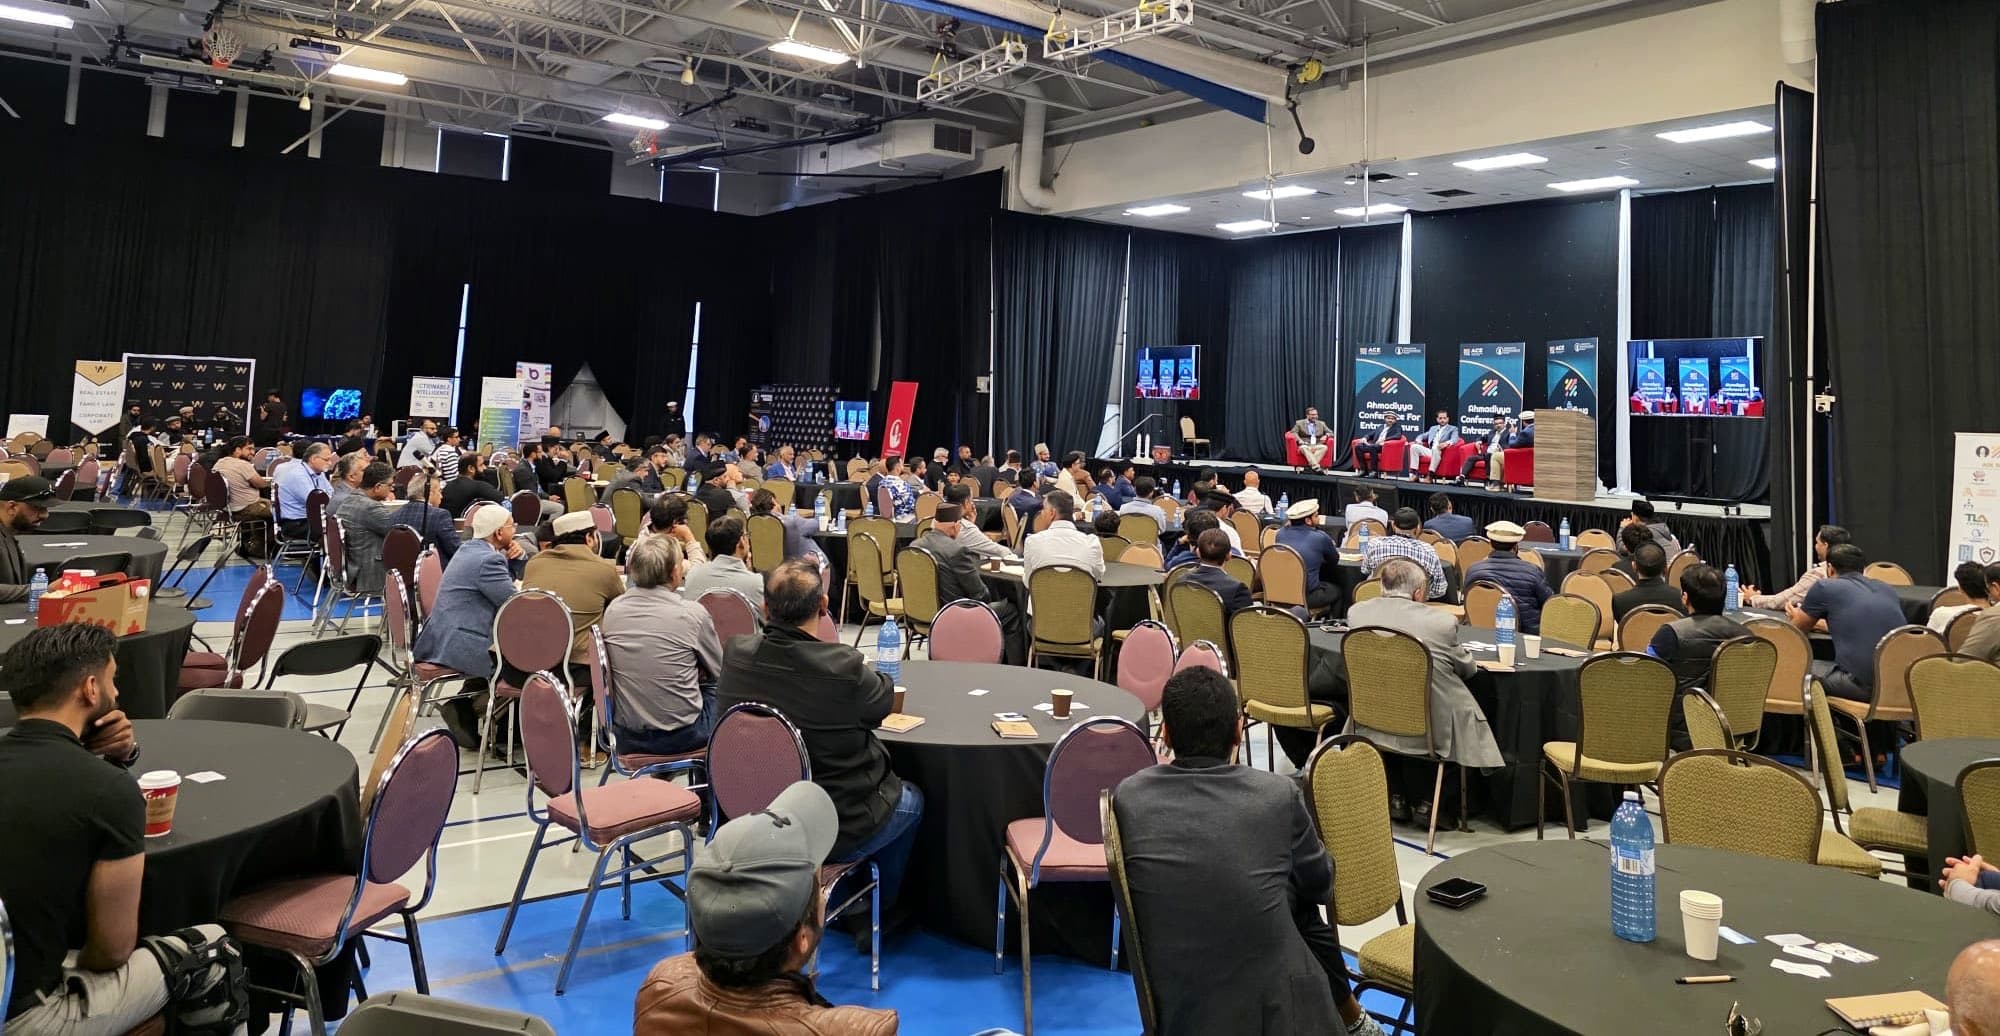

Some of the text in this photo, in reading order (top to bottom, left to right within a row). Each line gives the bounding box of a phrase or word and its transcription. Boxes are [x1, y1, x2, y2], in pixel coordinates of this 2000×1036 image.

[152, 363, 166, 371] W
[194, 364, 208, 373] W
[234, 366, 248, 375] W
[129, 380, 143, 389] W
[172, 382, 185, 390] W
[213, 383, 227, 391] W
[1366, 401, 1413, 412] Ahmadiyya
[1468, 405, 1511, 415] Ahmadiyya
[1406, 413, 1421, 421] For
